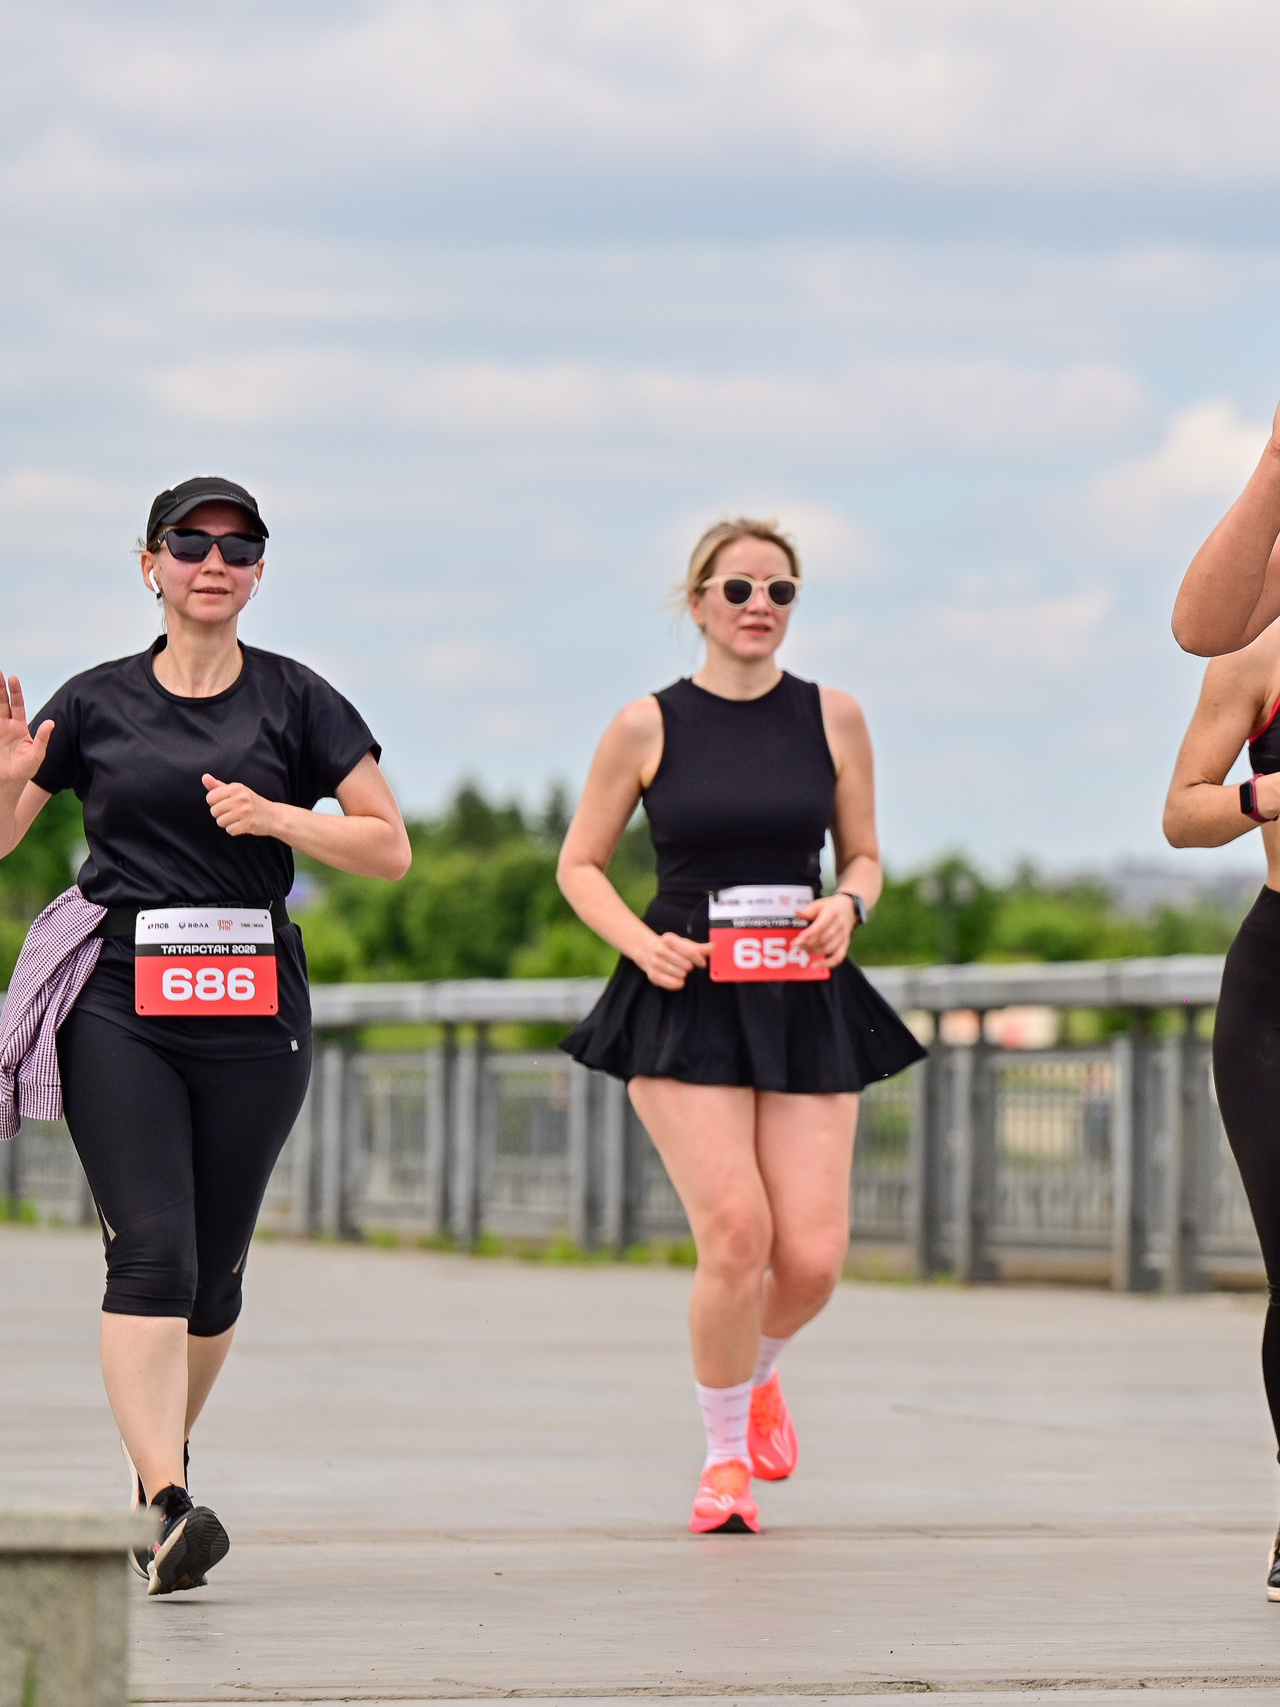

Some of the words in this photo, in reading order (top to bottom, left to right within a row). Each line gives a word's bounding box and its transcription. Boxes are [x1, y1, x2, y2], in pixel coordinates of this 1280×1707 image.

[161, 945, 229, 955] ТАТАРСТАН
[733, 937, 810, 969] 654
[162, 967, 255, 1001] 686
